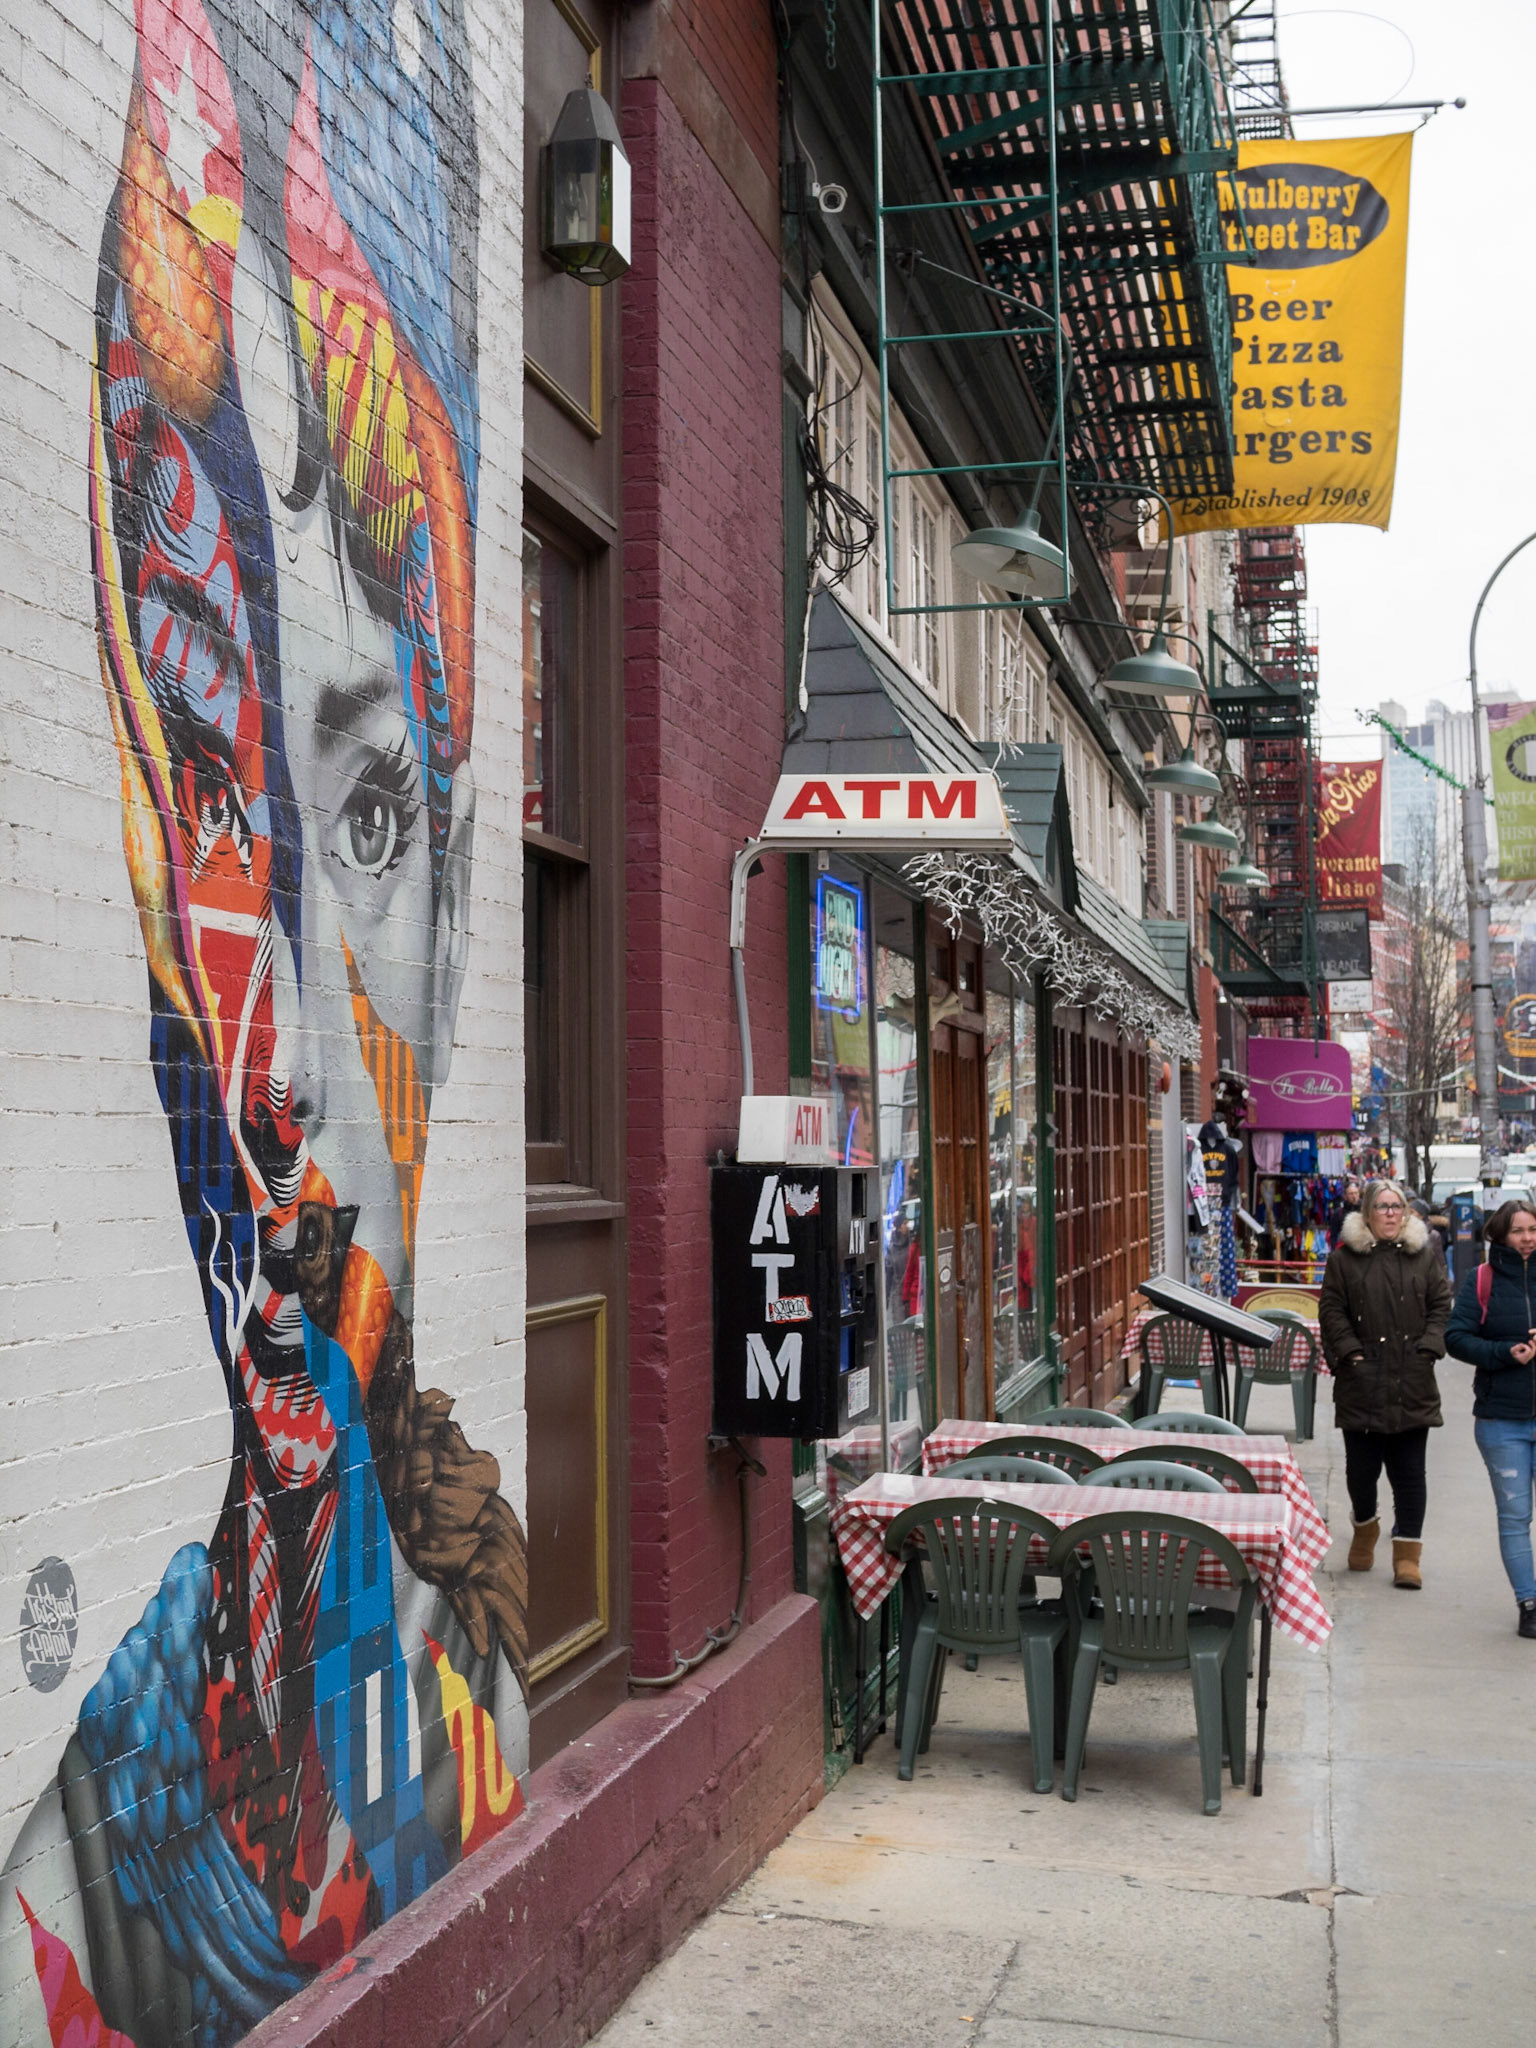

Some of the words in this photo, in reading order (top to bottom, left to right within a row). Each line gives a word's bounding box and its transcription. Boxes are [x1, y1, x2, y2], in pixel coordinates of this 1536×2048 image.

[1217, 178, 1361, 217] Mulberry
[1222, 217, 1299, 251] treet
[1306, 216, 1361, 250] Bar
[1231, 293, 1332, 322] Beer
[1230, 378, 1347, 410] asta
[1181, 487, 1312, 515] Established
[1319, 487, 1371, 508] 1908
[782, 780, 977, 820] ATM
[1328, 766, 1378, 812] Nico
[1499, 810, 1518, 825] TO
[794, 1105, 822, 1146] ATM
[1461, 1207, 1471, 1219] P
[848, 1219, 865, 1255] ATM
[745, 1175, 802, 1401] ATM
